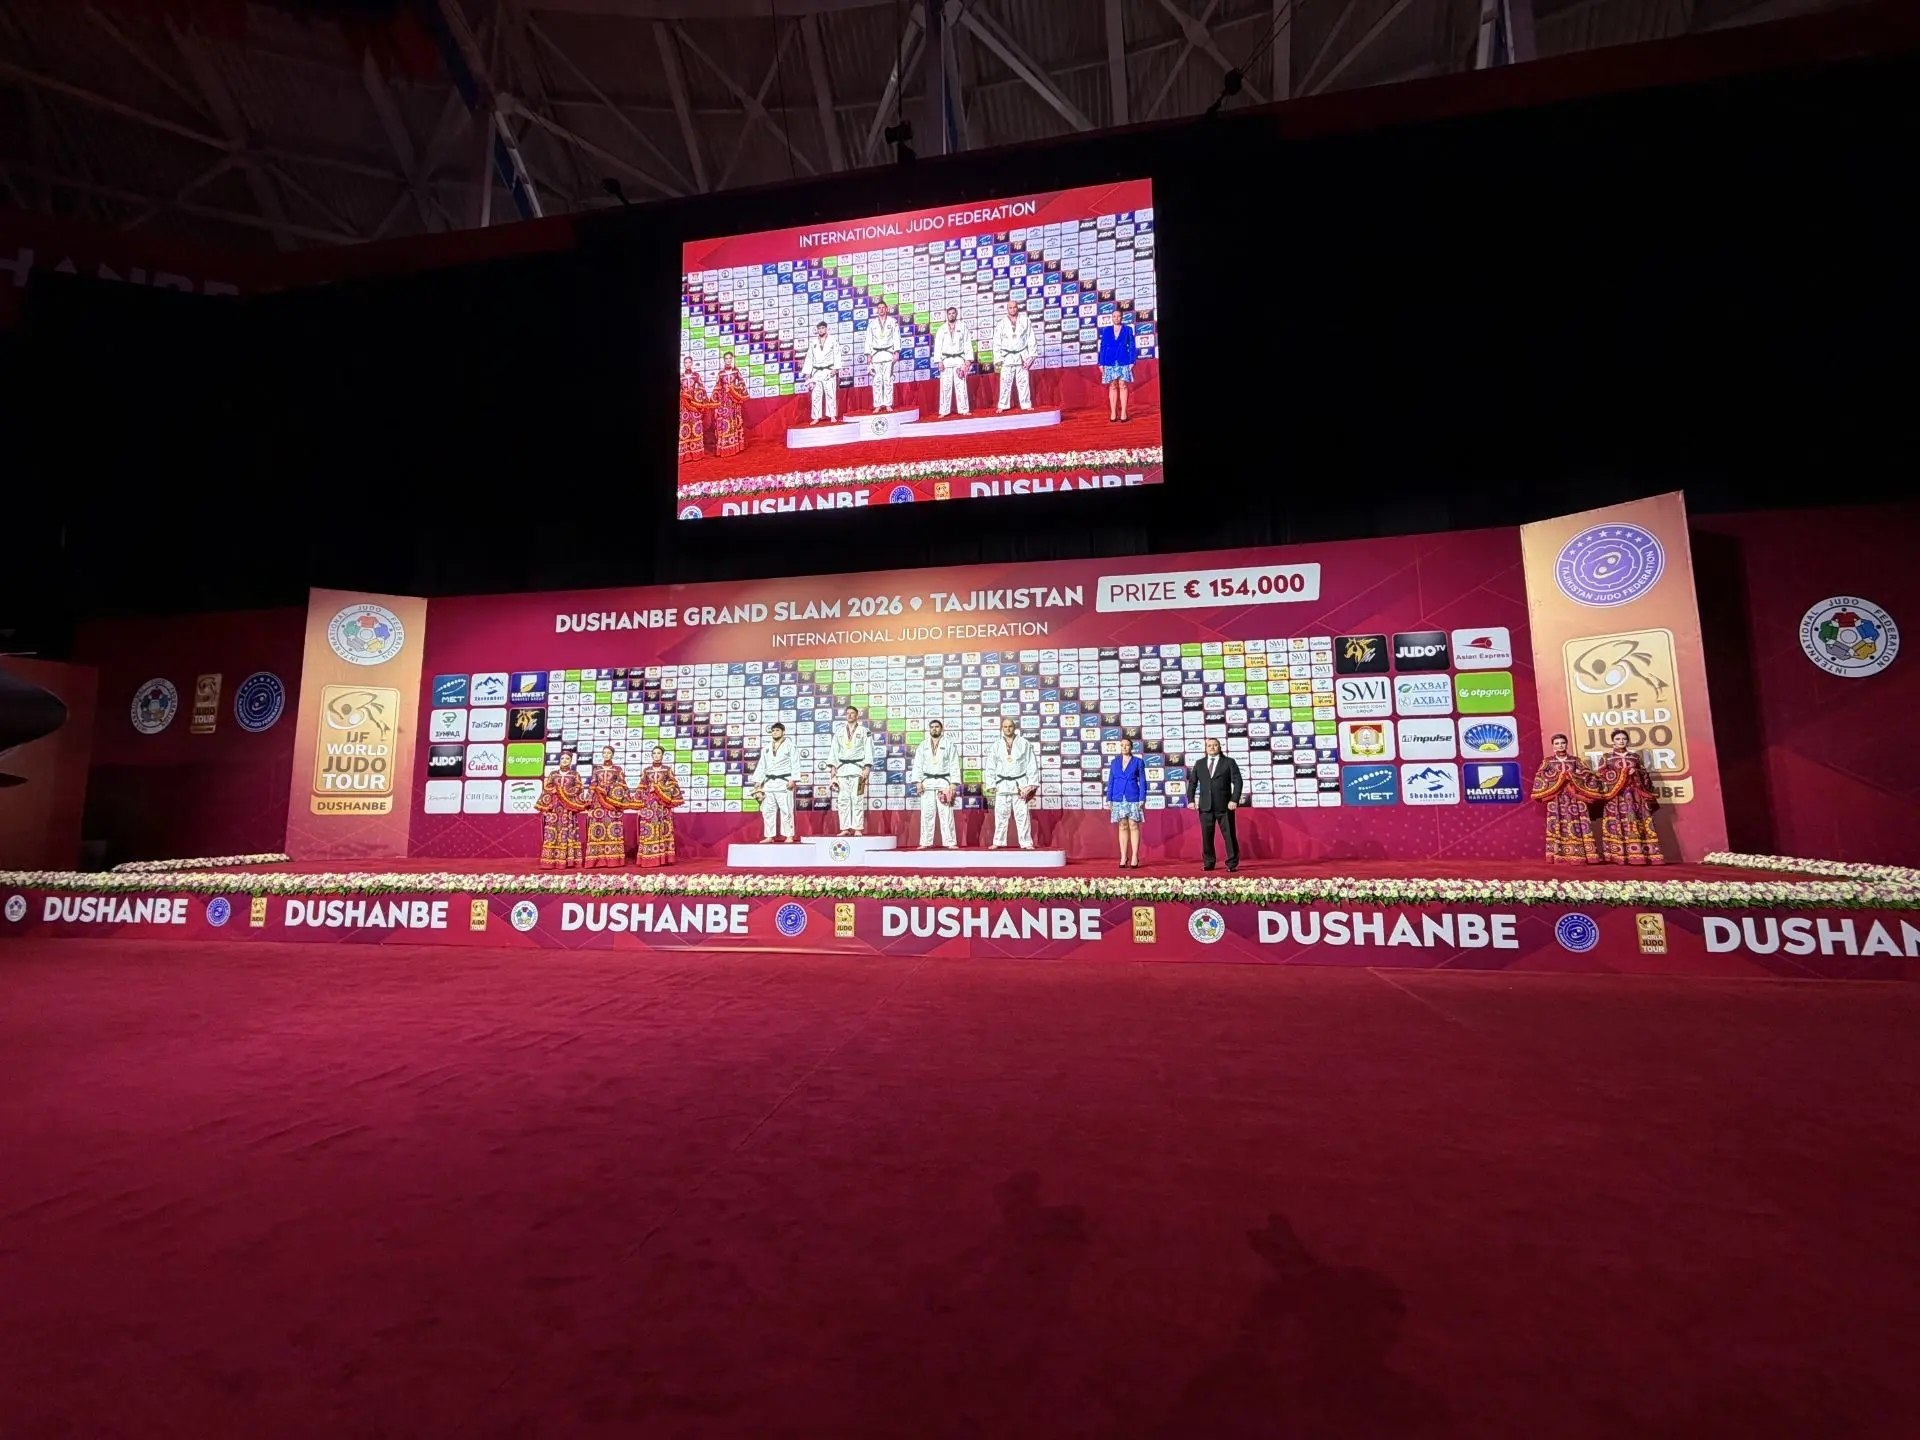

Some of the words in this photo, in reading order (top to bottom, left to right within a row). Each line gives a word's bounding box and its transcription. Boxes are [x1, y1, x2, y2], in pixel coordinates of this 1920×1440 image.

[799, 223, 902, 248] INTERNATIONAL
[906, 215, 944, 234] JUDO
[947, 199, 1036, 227] FEDERATION
[1110, 581, 1177, 603] PRIZE
[1184, 579, 1201, 599] €
[1209, 573, 1305, 599] 154,000
[1560, 565, 1593, 600] TAJIKISTAN
[1594, 592, 1622, 601] JUDO
[1622, 550, 1657, 597] FEDERATION
[357, 605, 382, 613] JUDO
[555, 608, 678, 633] DUSHANBE
[683, 603, 768, 626] GRAND
[773, 598, 841, 622] SLAM
[848, 595, 903, 617] 2026
[929, 585, 1084, 613] TAJIKISTAN
[771, 629, 893, 648] INTERNATIONAL
[897, 626, 943, 642] JUDO
[947, 621, 1048, 640] FEDERATION
[1801, 610, 1847, 675] INTERNATIONAL
[1828, 597, 1860, 607] JUDO
[1873, 608, 1897, 668] FEDERATION
[1342, 681, 1387, 701] SWI
[1606, 692, 1639, 710] IJF
[194, 715, 215, 723] TOUR
[1582, 707, 1672, 727] WORLD
[327, 743, 388, 756] WORLD
[346, 731, 370, 743] IJF
[1583, 724, 1673, 750] JUDO
[322, 756, 387, 773] JUDO
[1584, 748, 1677, 771] TR
[322, 773, 386, 790] TOUR
[317, 801, 387, 811] DUSHANBE
[43, 896, 188, 924] DUSHANBE
[284, 899, 449, 929] DUSHANBE
[561, 902, 749, 934] DUSHANBE
[882, 906, 1102, 940] DUSHANBE
[1257, 910, 1520, 949] DUSHANBE
